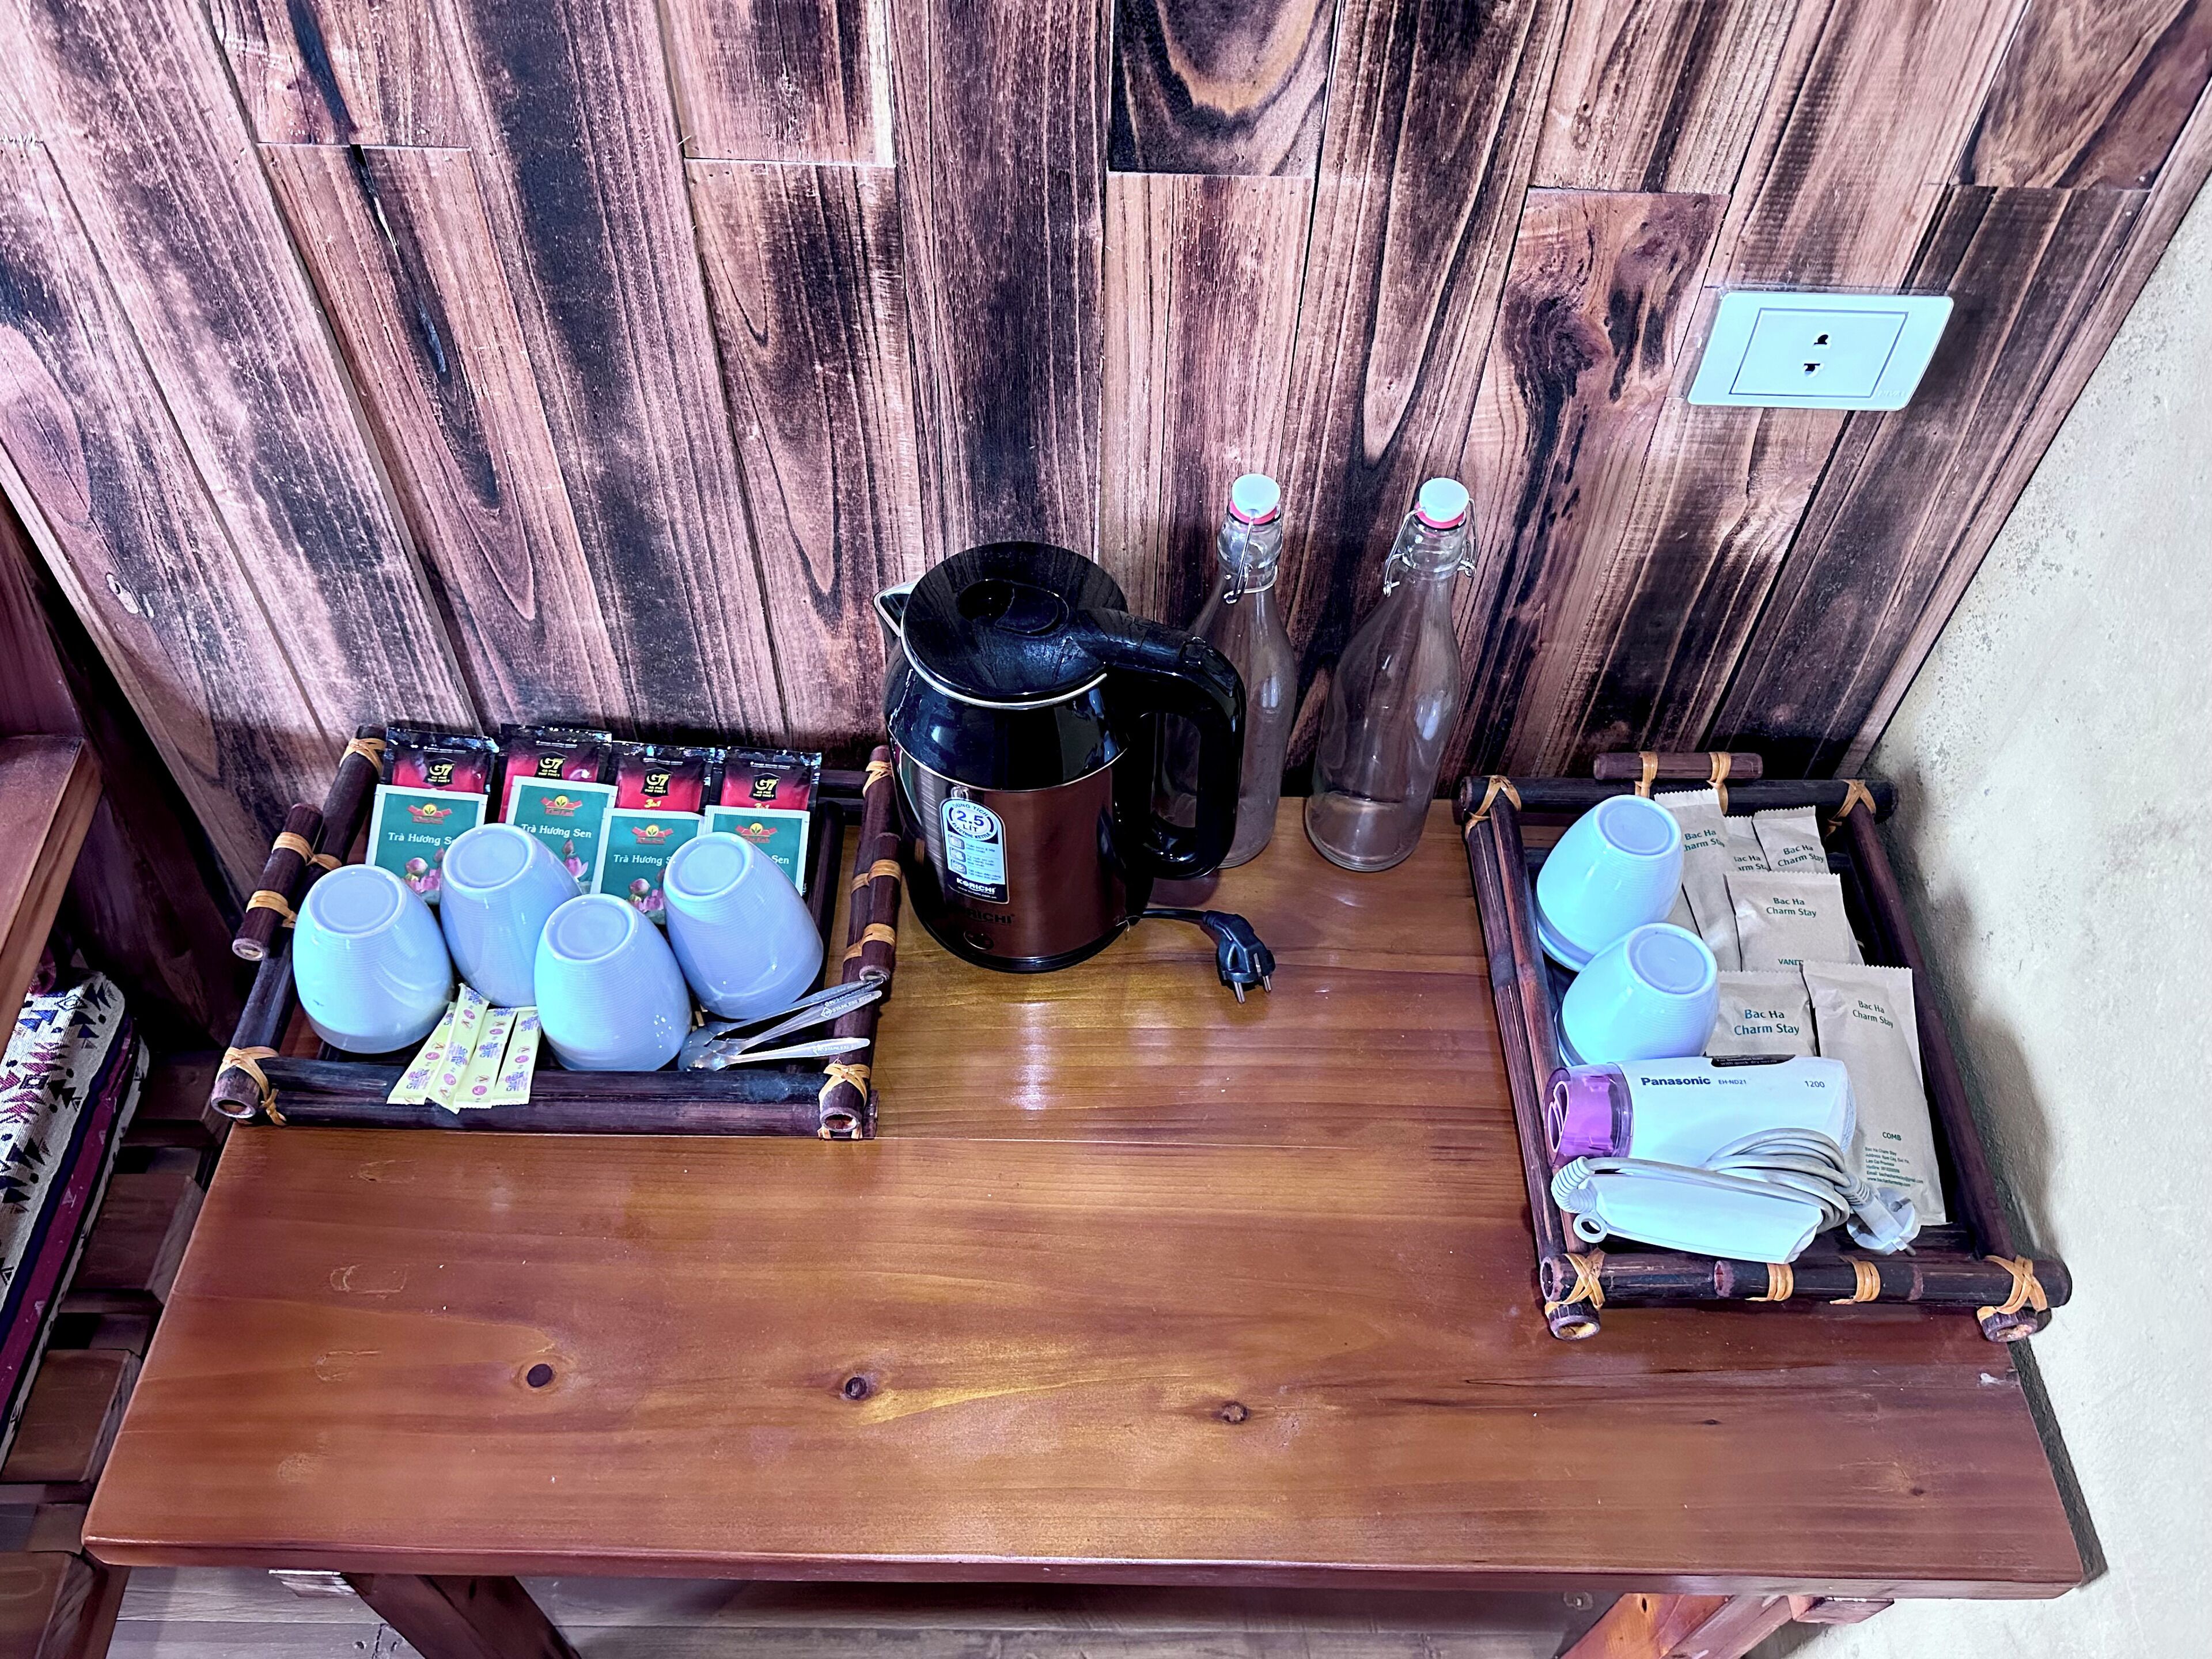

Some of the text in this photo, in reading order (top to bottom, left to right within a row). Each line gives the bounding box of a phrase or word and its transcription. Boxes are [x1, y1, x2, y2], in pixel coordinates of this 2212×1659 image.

[540, 757, 566, 770] G7
[429, 764, 455, 776] G7
[646, 774, 671, 786] G7
[755, 779, 779, 791] G7
[957, 810, 984, 826] 2.5
[539, 825, 570, 838] Hương
[573, 828, 592, 838] Sen
[963, 824, 978, 832] LÍT
[388, 832, 404, 841] Trà
[408, 835, 441, 846] Hương
[1684, 832, 1702, 840] Bac
[1684, 841, 1709, 852] harm
[1783, 845, 1801, 855] Bac
[613, 854, 629, 863] Trà
[632, 855, 662, 866] Hương
[772, 855, 789, 864] Sen
[1778, 851, 1824, 867] Charm Stay
[956, 877, 996, 894] KORICHI
[1766, 907, 1817, 918] Charm Stay
[1858, 1000, 1885, 1014] Bac Ha
[1744, 1009, 1785, 1019] Bac Ha
[1853, 1009, 1893, 1029] Charm Stay
[1734, 1023, 1800, 1036] Charm Stay
[1641, 1076, 1711, 1086] Panasonic
[1883, 1131, 1902, 1141] COMB
